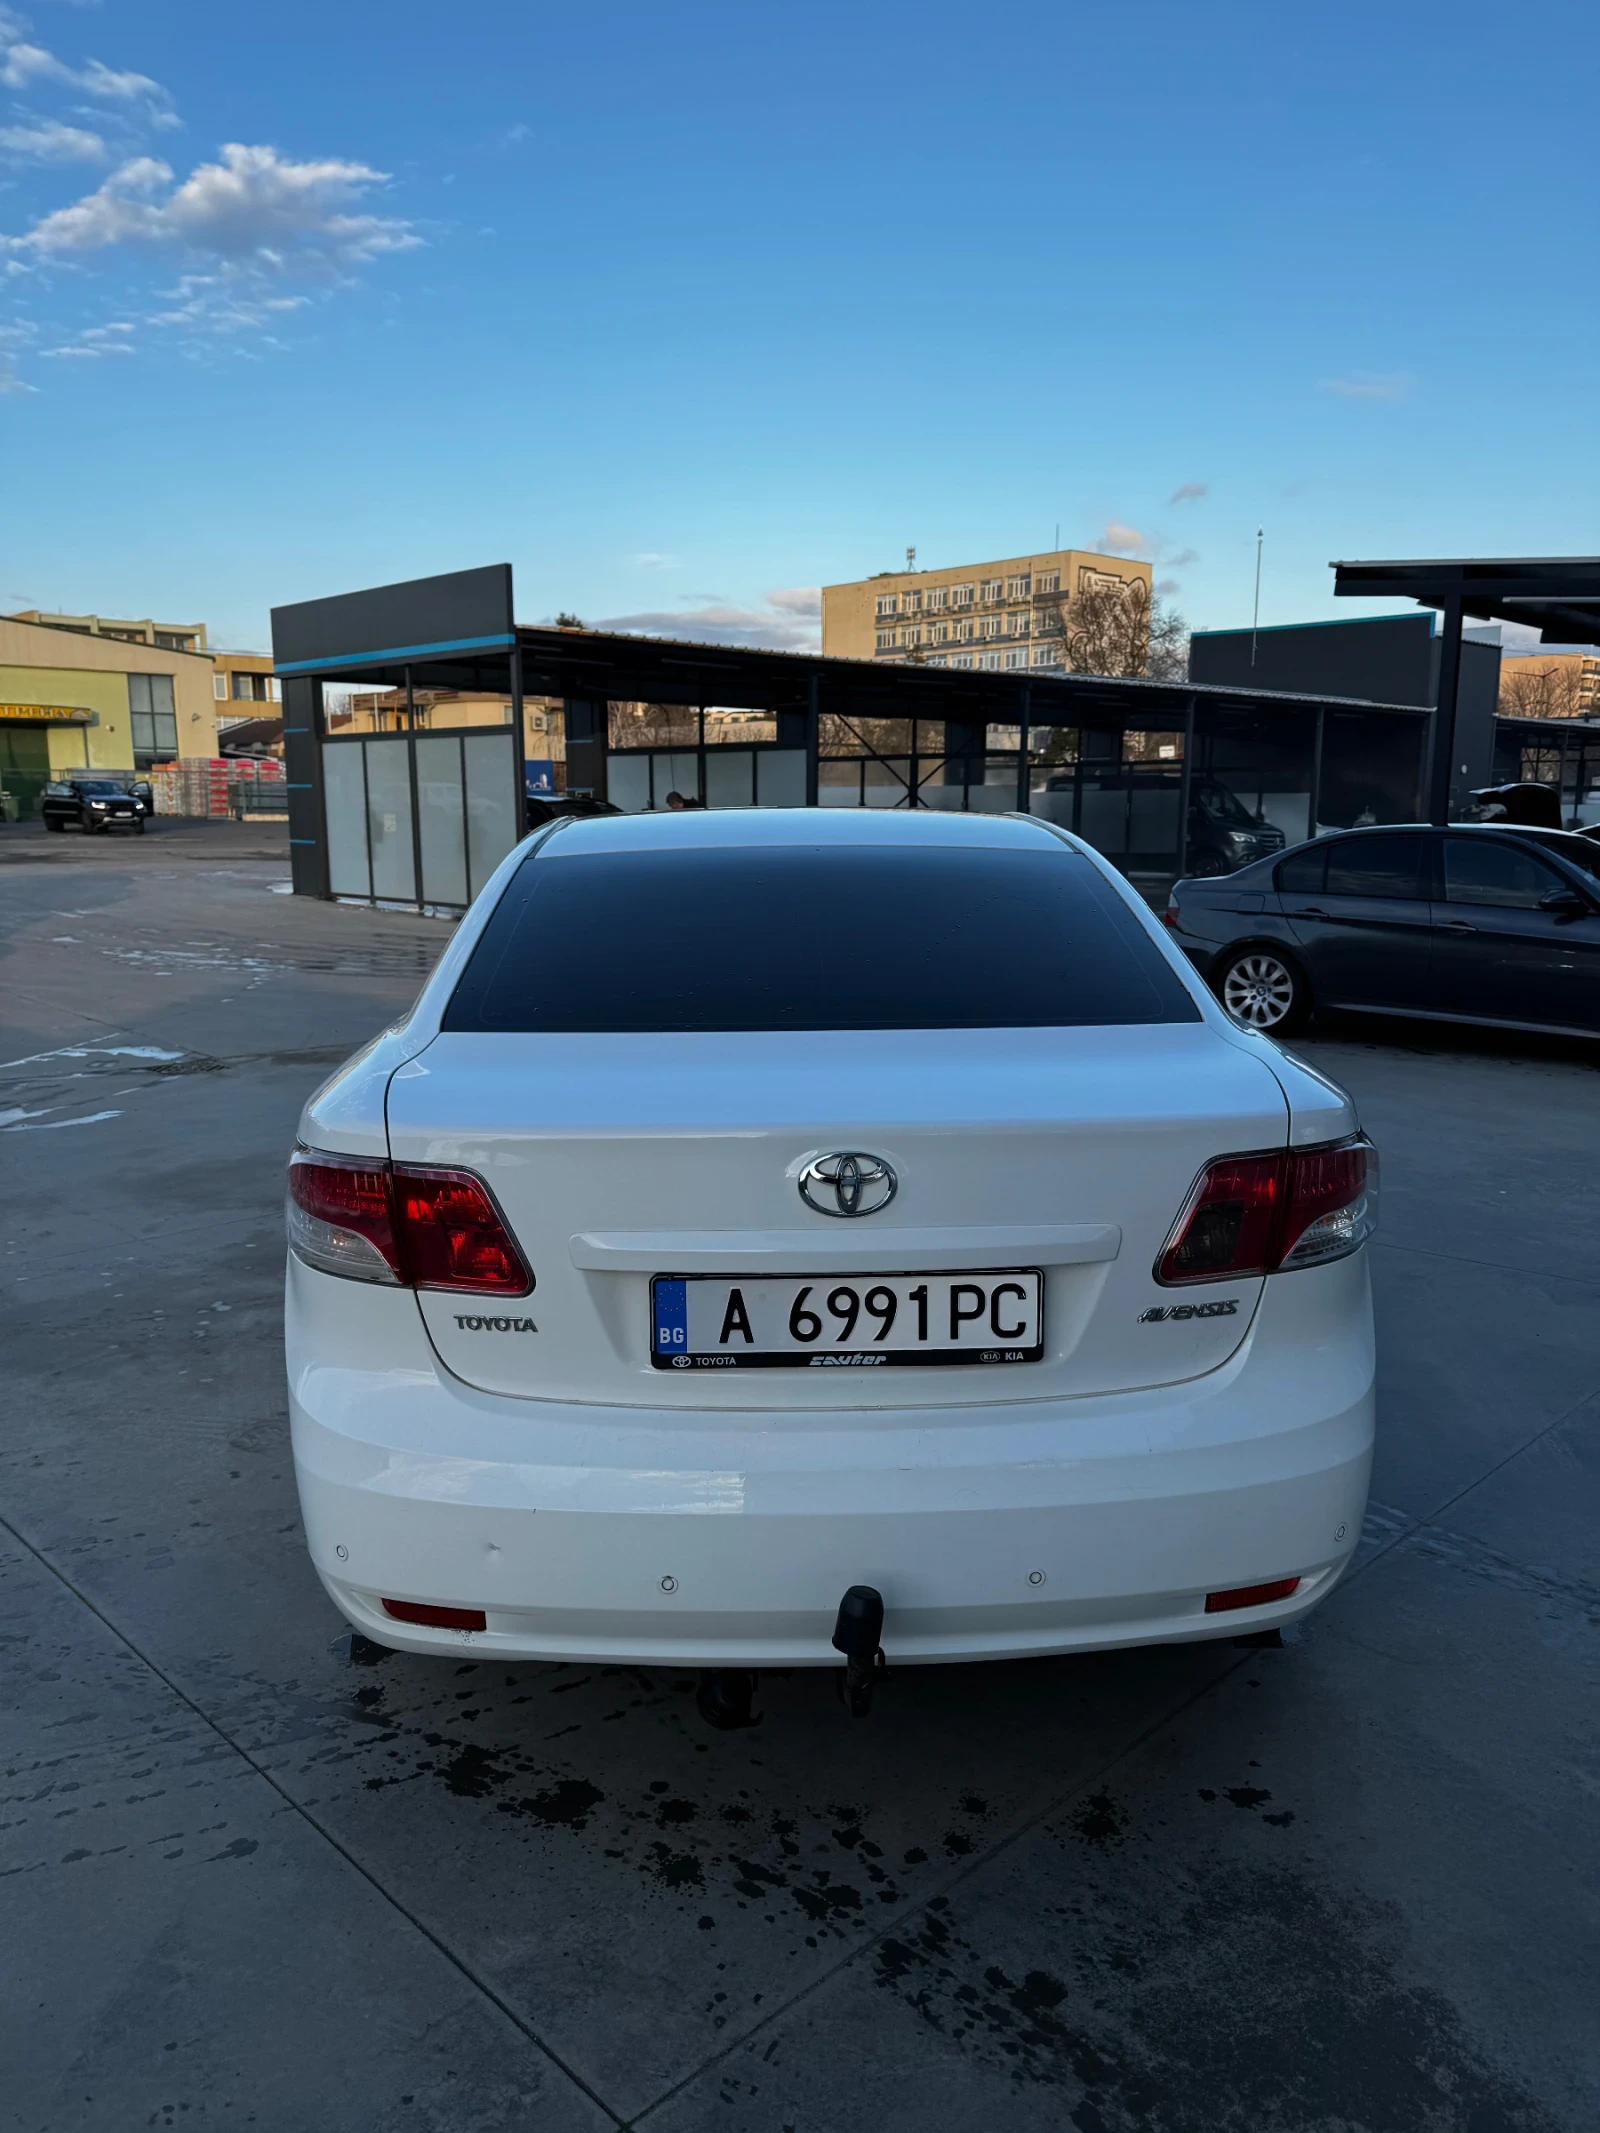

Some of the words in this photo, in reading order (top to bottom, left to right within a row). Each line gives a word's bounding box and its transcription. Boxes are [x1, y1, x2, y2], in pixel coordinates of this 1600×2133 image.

[719, 1287, 754, 1343] A
[789, 1285, 928, 1342] 6991
[949, 1283, 1027, 1339] PC
[1137, 1299, 1240, 1323] AVENSIS
[453, 1314, 538, 1332] TOYOTA
[659, 1327, 685, 1344] BG
[695, 1357, 737, 1366] TOYOTA
[1005, 1352, 1024, 1360] KIA
